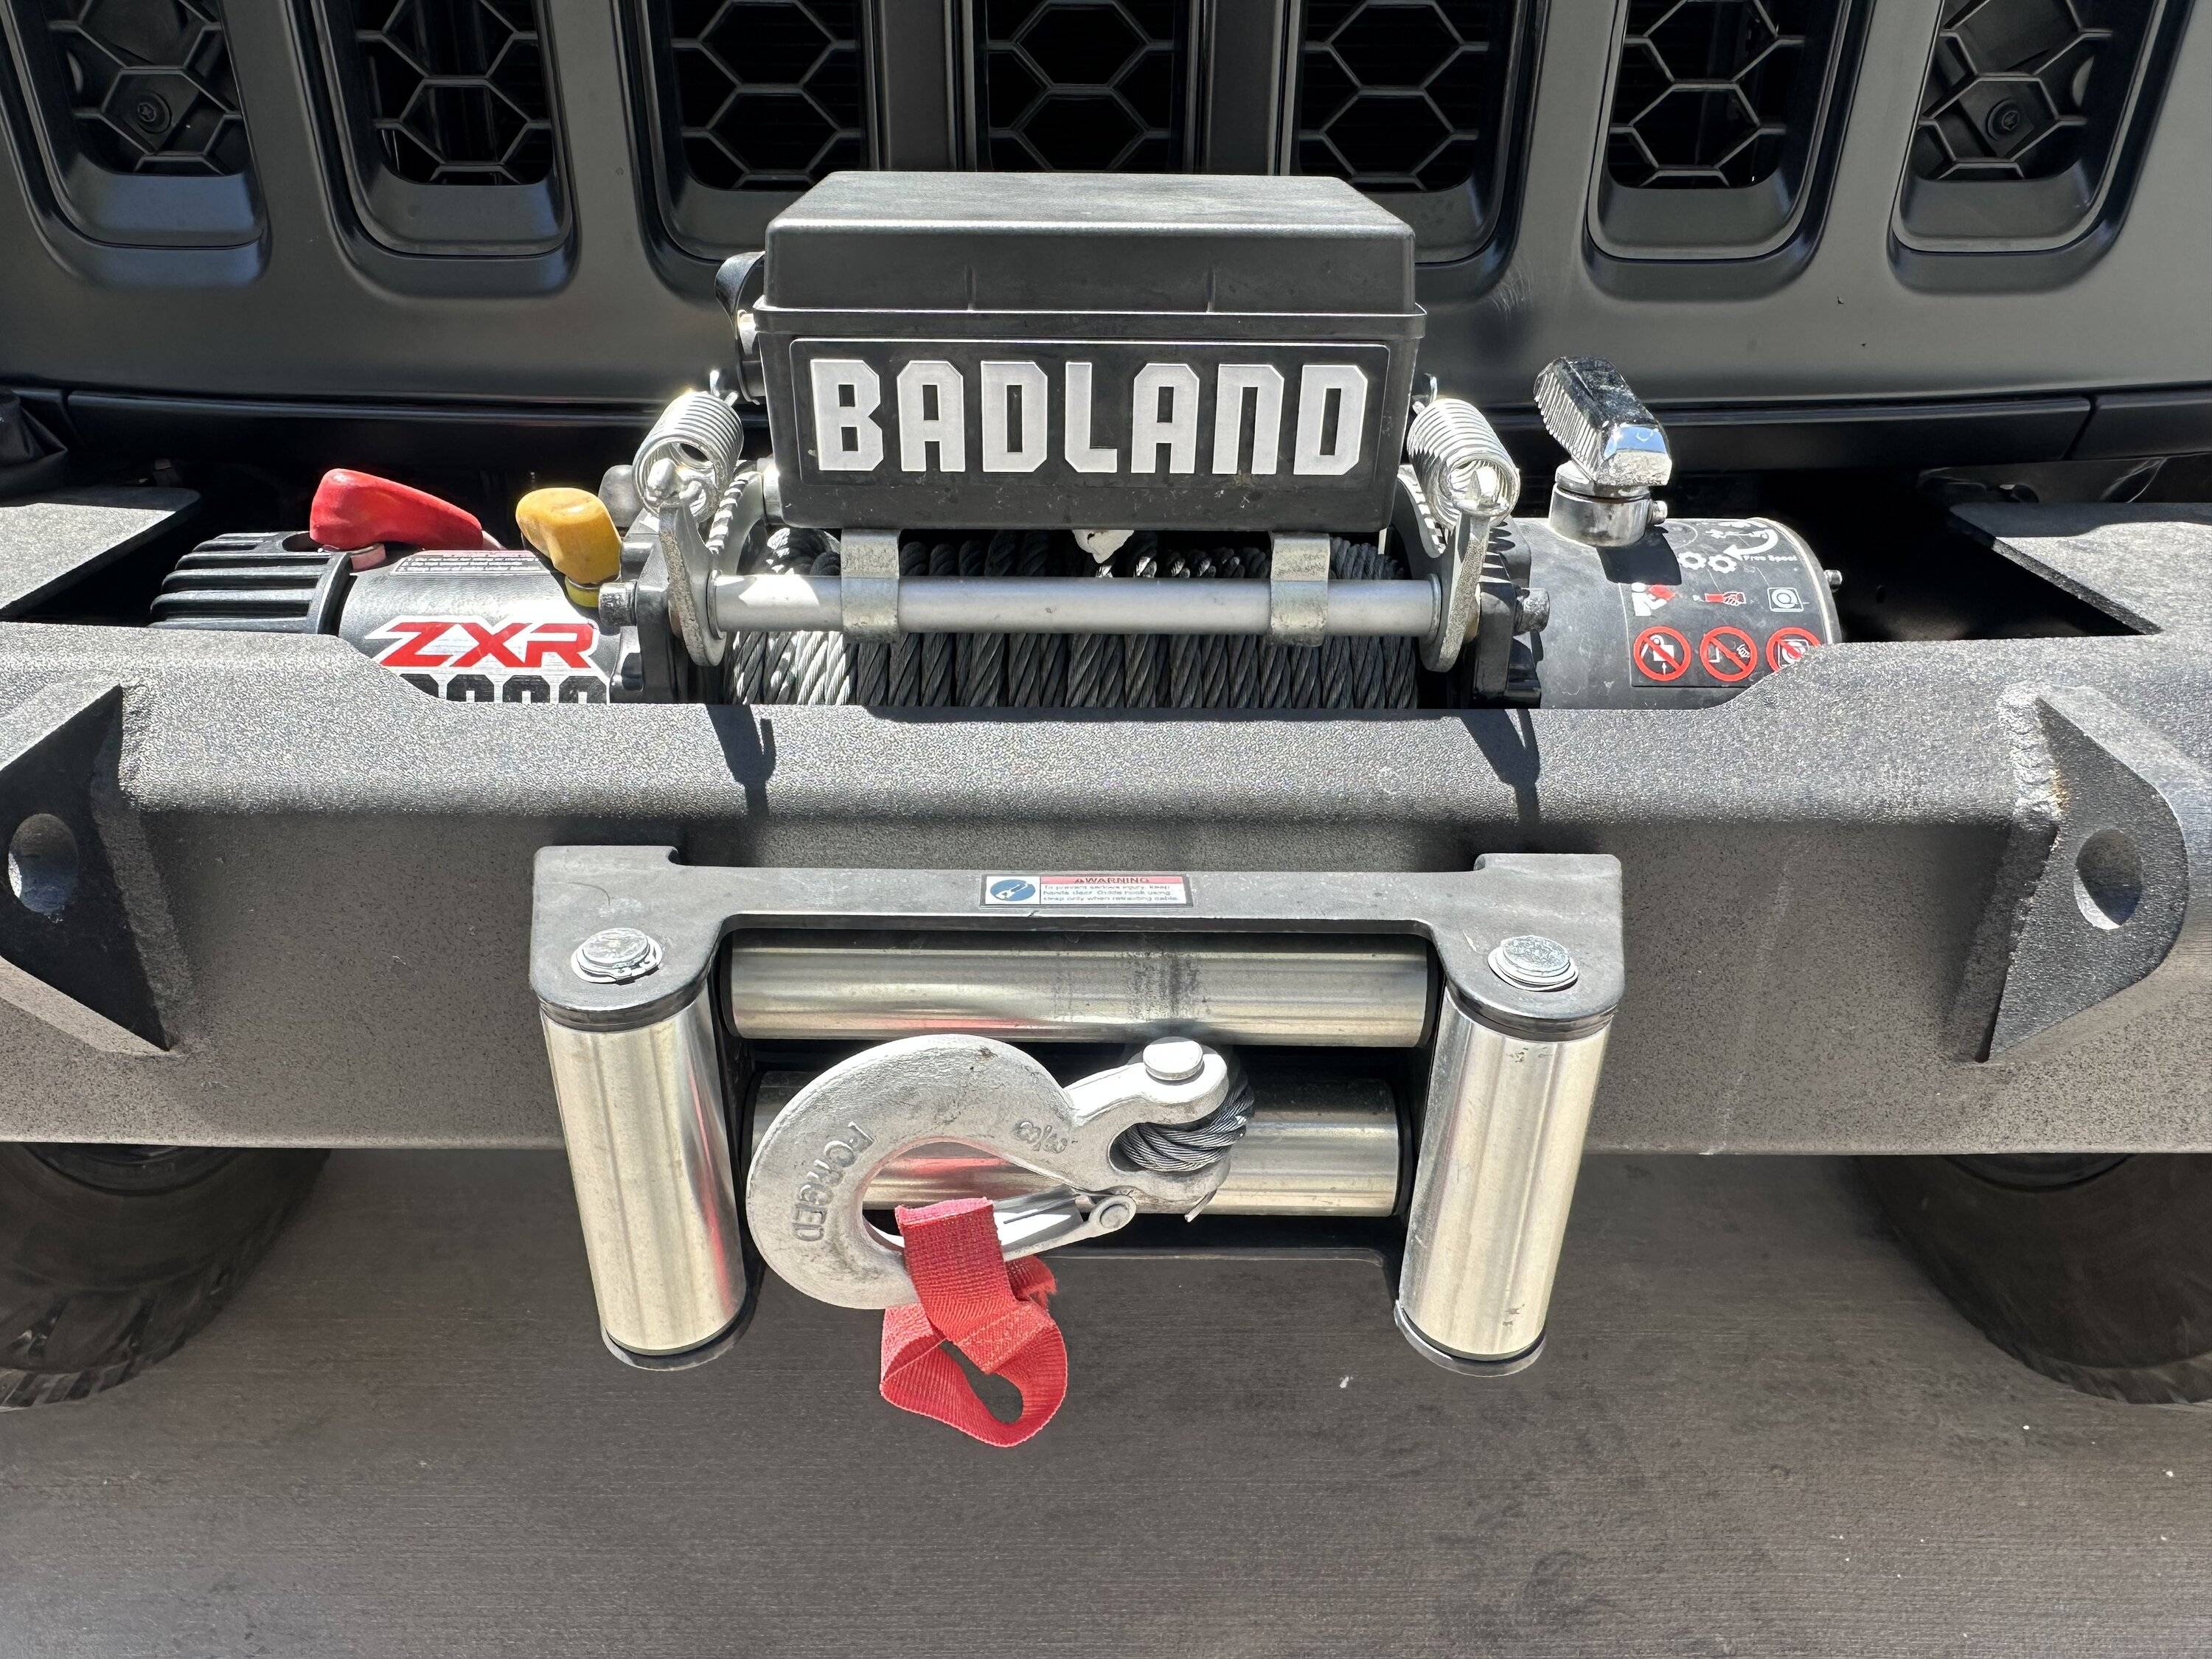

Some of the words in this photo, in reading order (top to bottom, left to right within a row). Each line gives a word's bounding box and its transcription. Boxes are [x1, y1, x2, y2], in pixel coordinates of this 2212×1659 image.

[810, 358, 1368, 476] BADLAND
[378, 621, 596, 669] ZXR
[792, 1121, 874, 1242] FORGED
